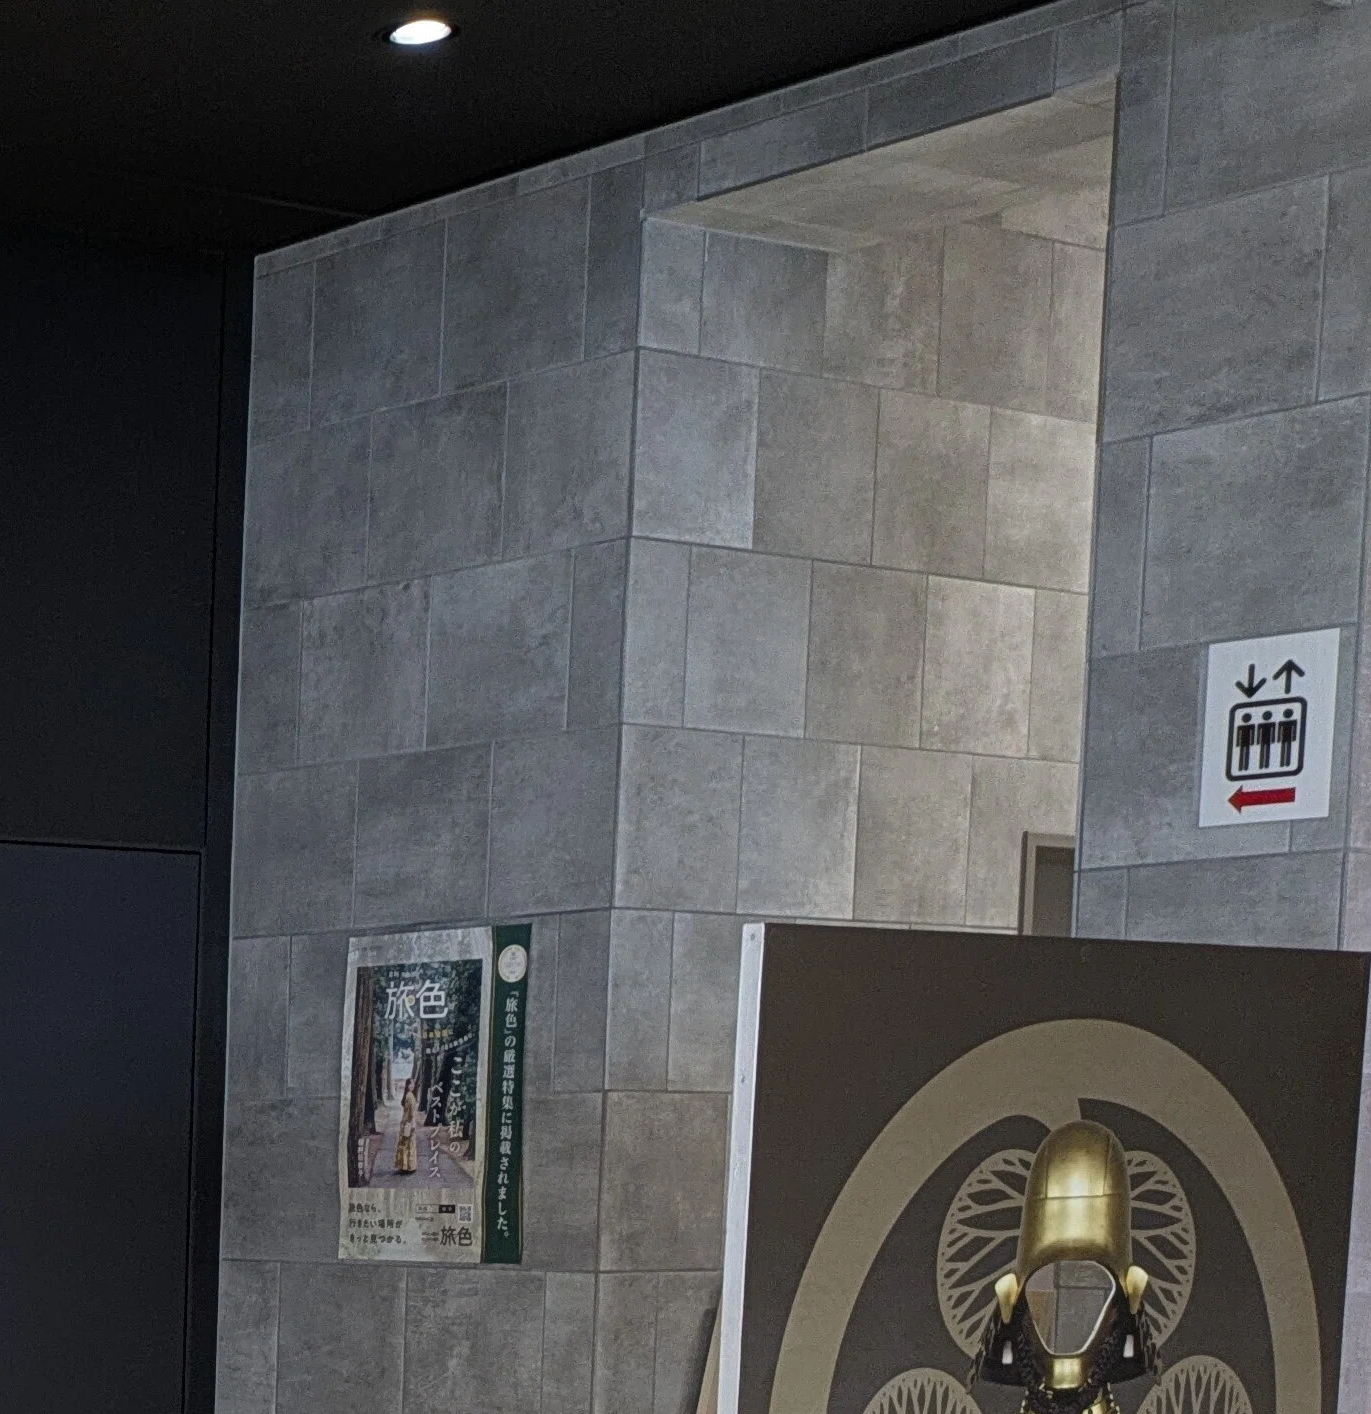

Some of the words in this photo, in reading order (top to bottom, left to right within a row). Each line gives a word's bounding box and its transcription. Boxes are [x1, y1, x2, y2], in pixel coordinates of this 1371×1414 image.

[384, 980, 449, 1020] 旅色
[428, 1080, 444, 1178] ベストプレイス
[448, 1056, 467, 1153] ここが私の
[439, 1225, 473, 1247] 旅色
